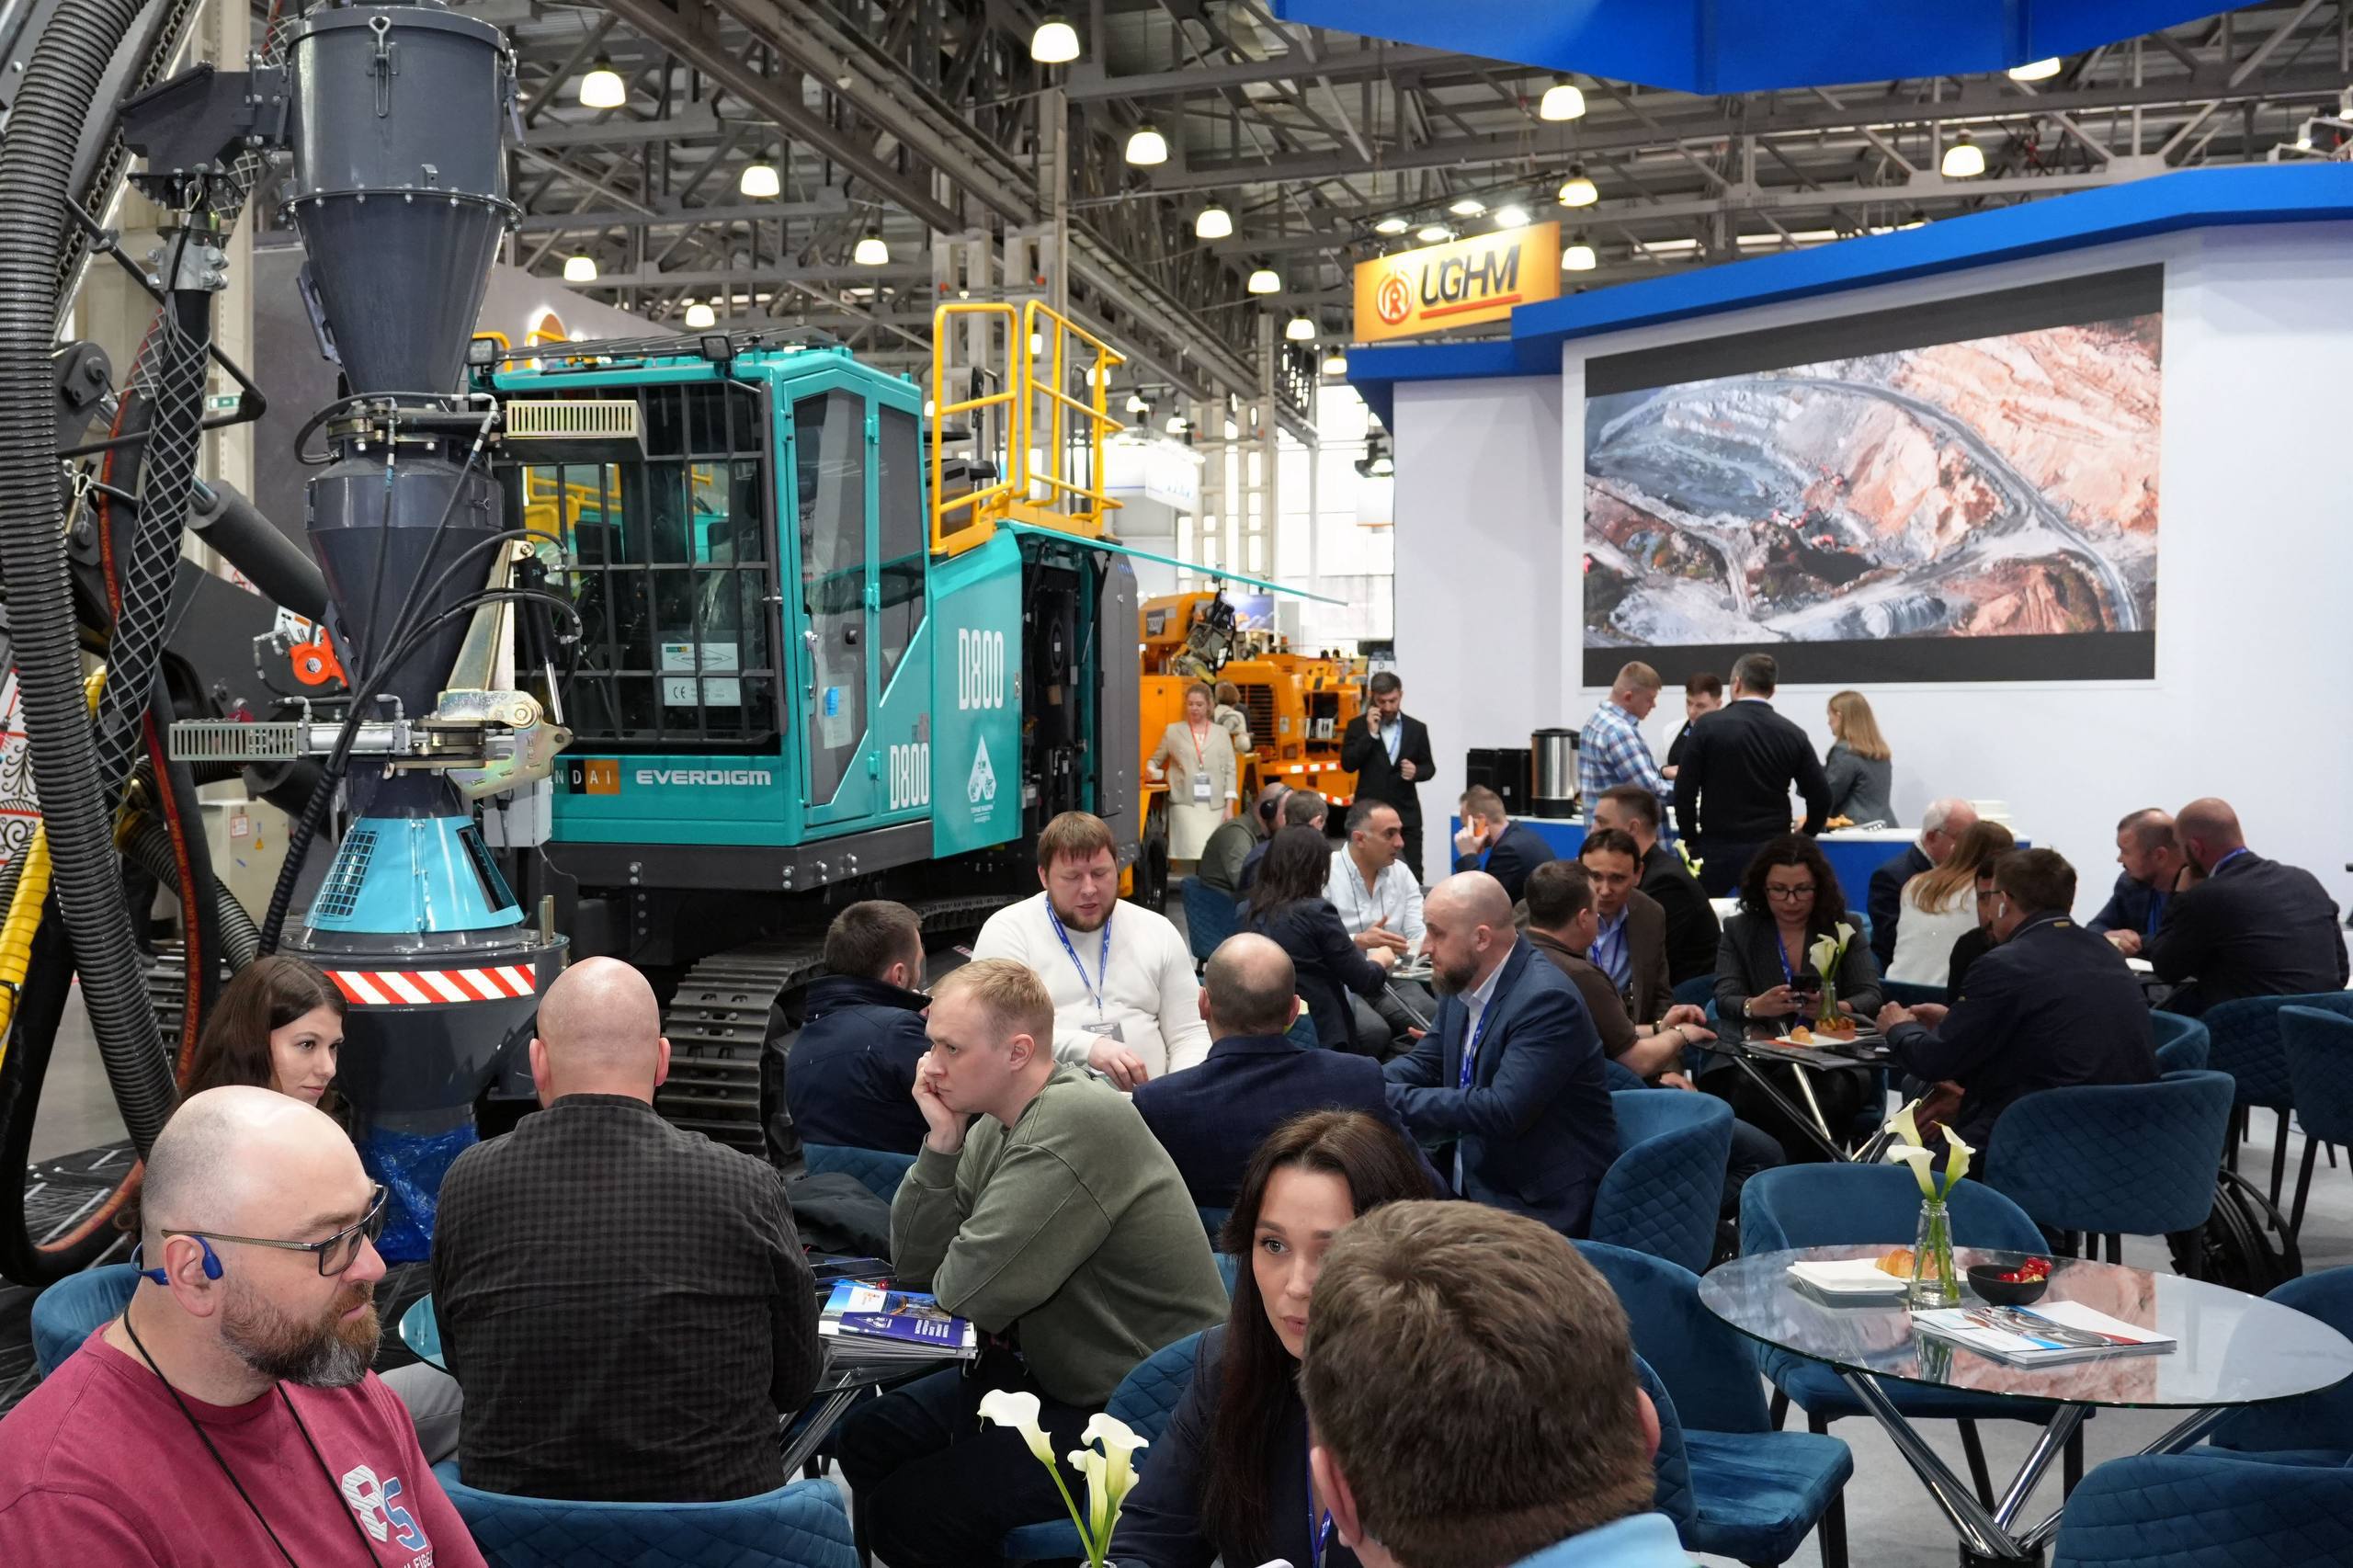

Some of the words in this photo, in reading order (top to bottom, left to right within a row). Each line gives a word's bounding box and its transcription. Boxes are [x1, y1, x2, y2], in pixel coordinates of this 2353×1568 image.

[959, 628, 1004, 710] D800
[554, 769, 611, 784] NDAI
[636, 769, 772, 786] EVERDIGM
[890, 742, 929, 810] D800
